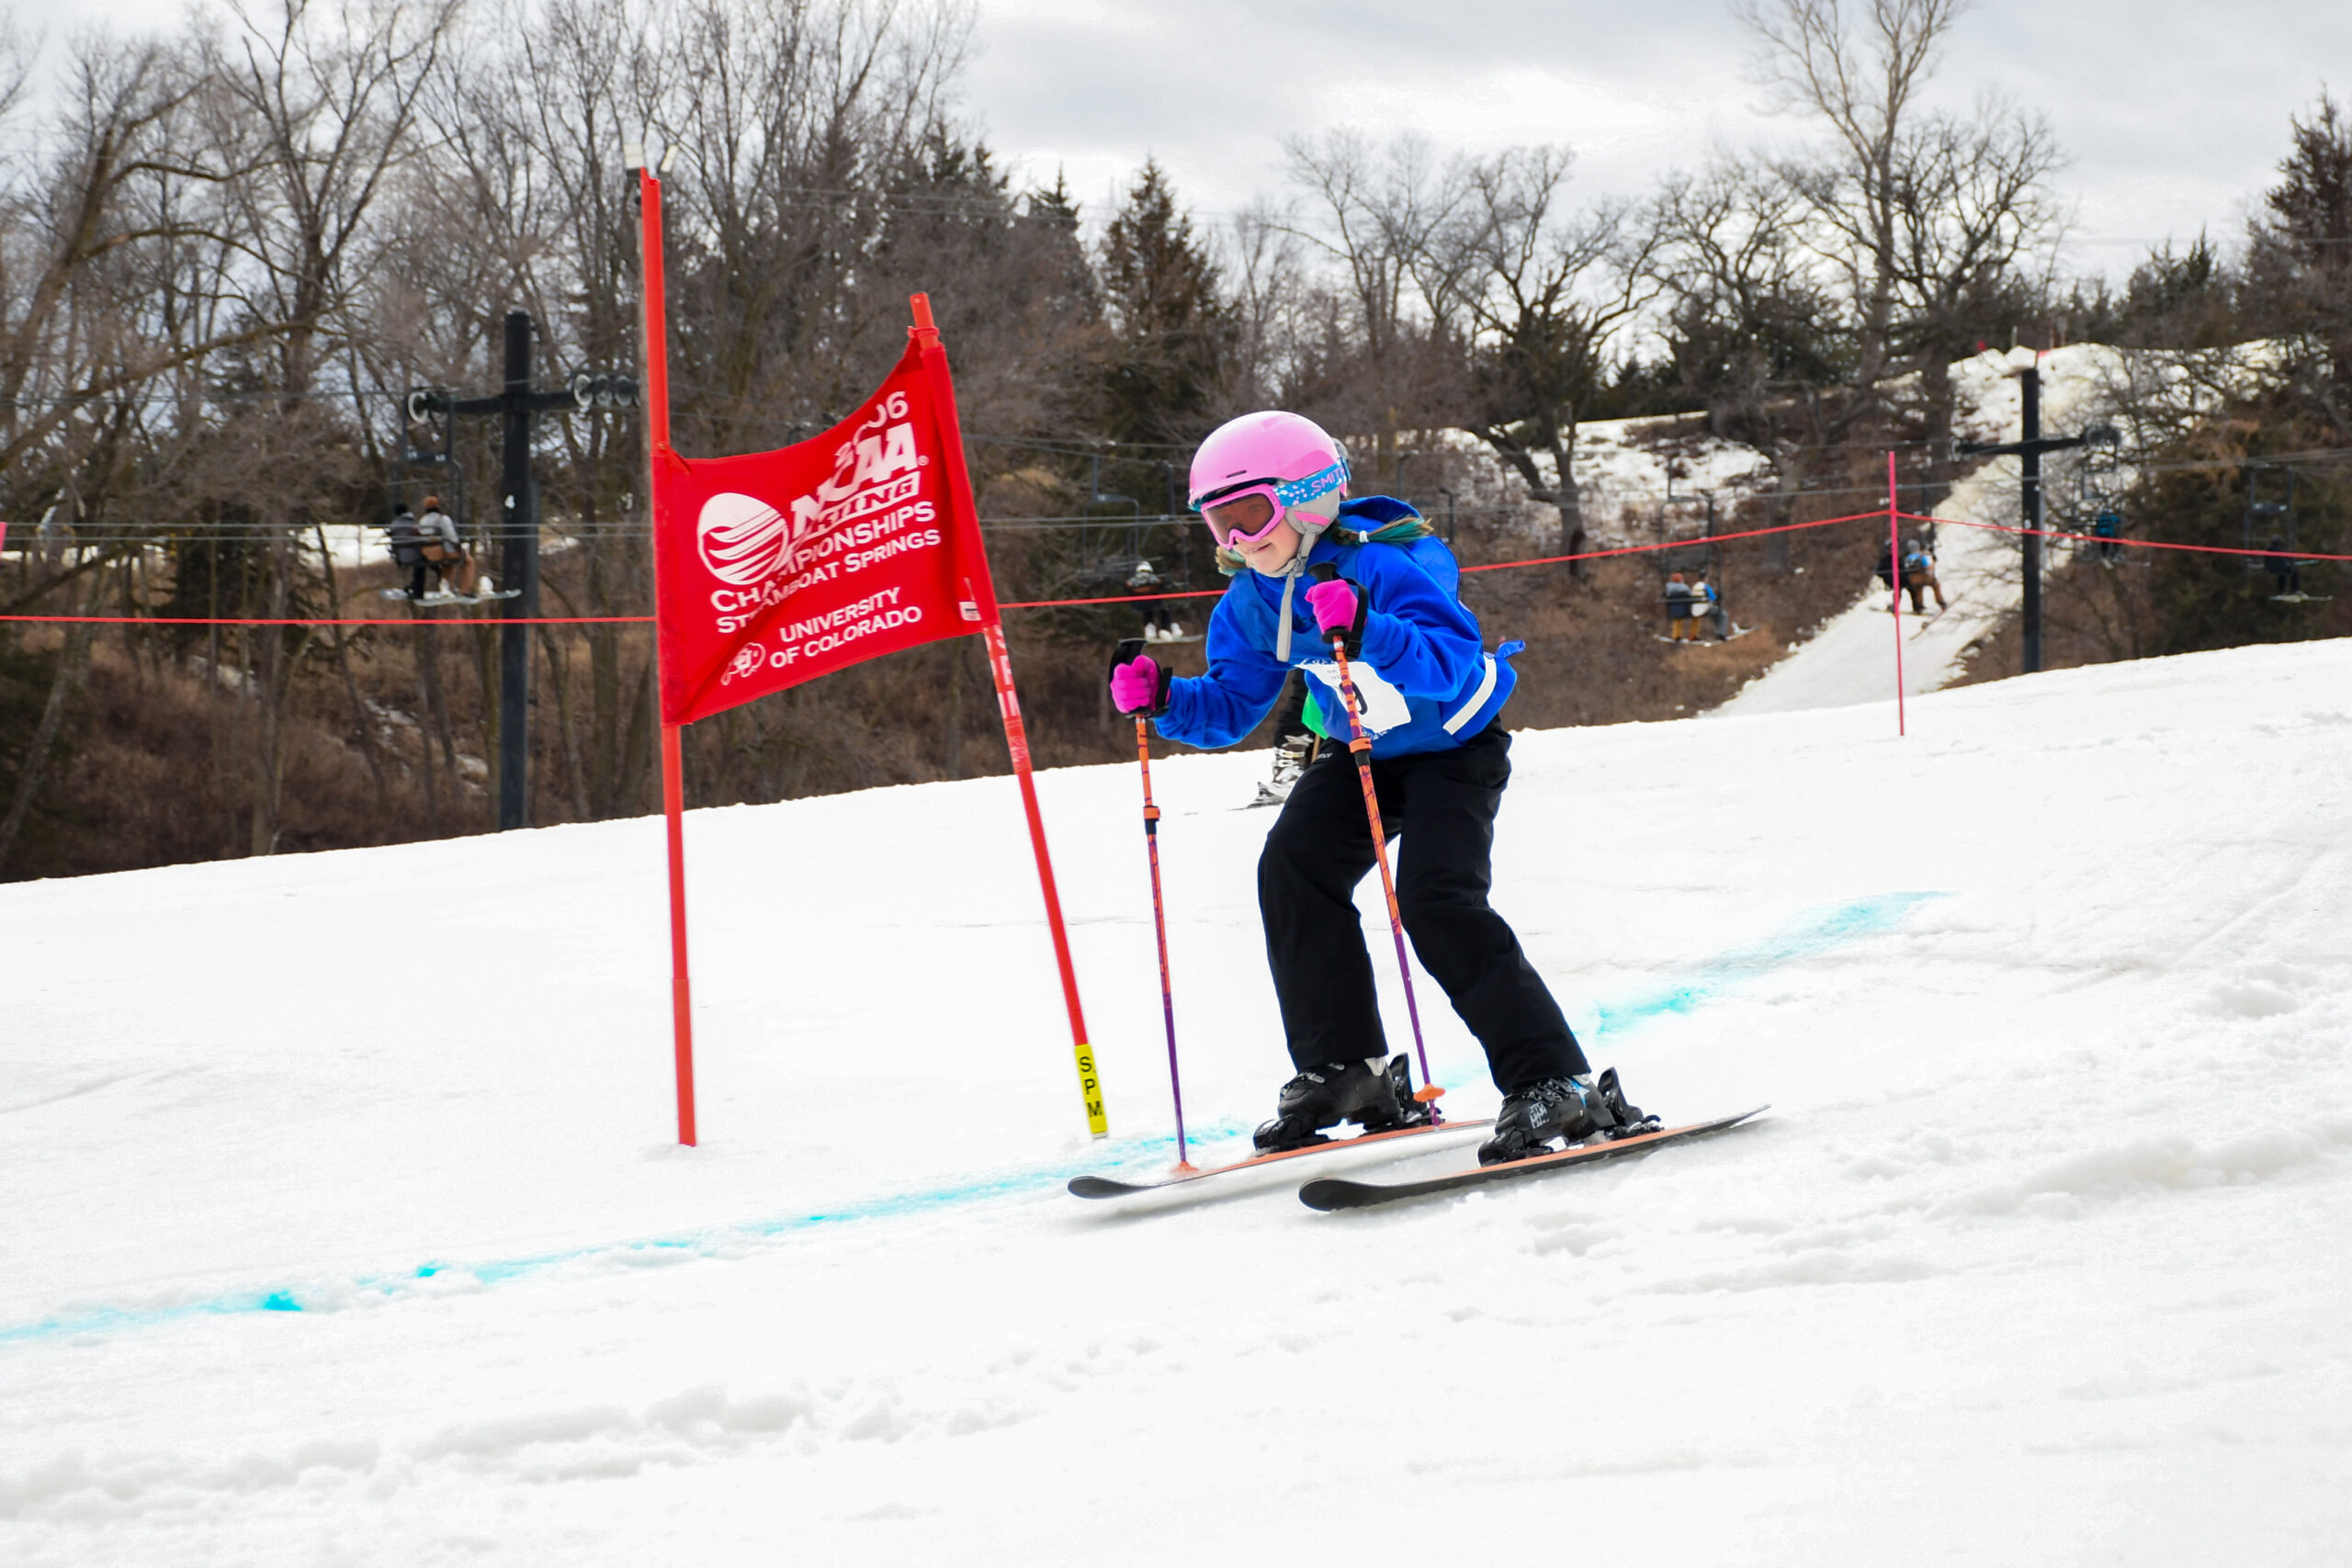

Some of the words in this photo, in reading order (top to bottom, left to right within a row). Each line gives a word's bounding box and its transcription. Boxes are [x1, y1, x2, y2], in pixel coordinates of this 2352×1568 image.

[710, 501, 935, 612] CHAPIONSHIPS
[845, 529, 942, 572] SPRINGS
[769, 647, 800, 668] OF
[804, 606, 922, 657] COLORADO
[779, 587, 900, 642] UNIVERSITY
